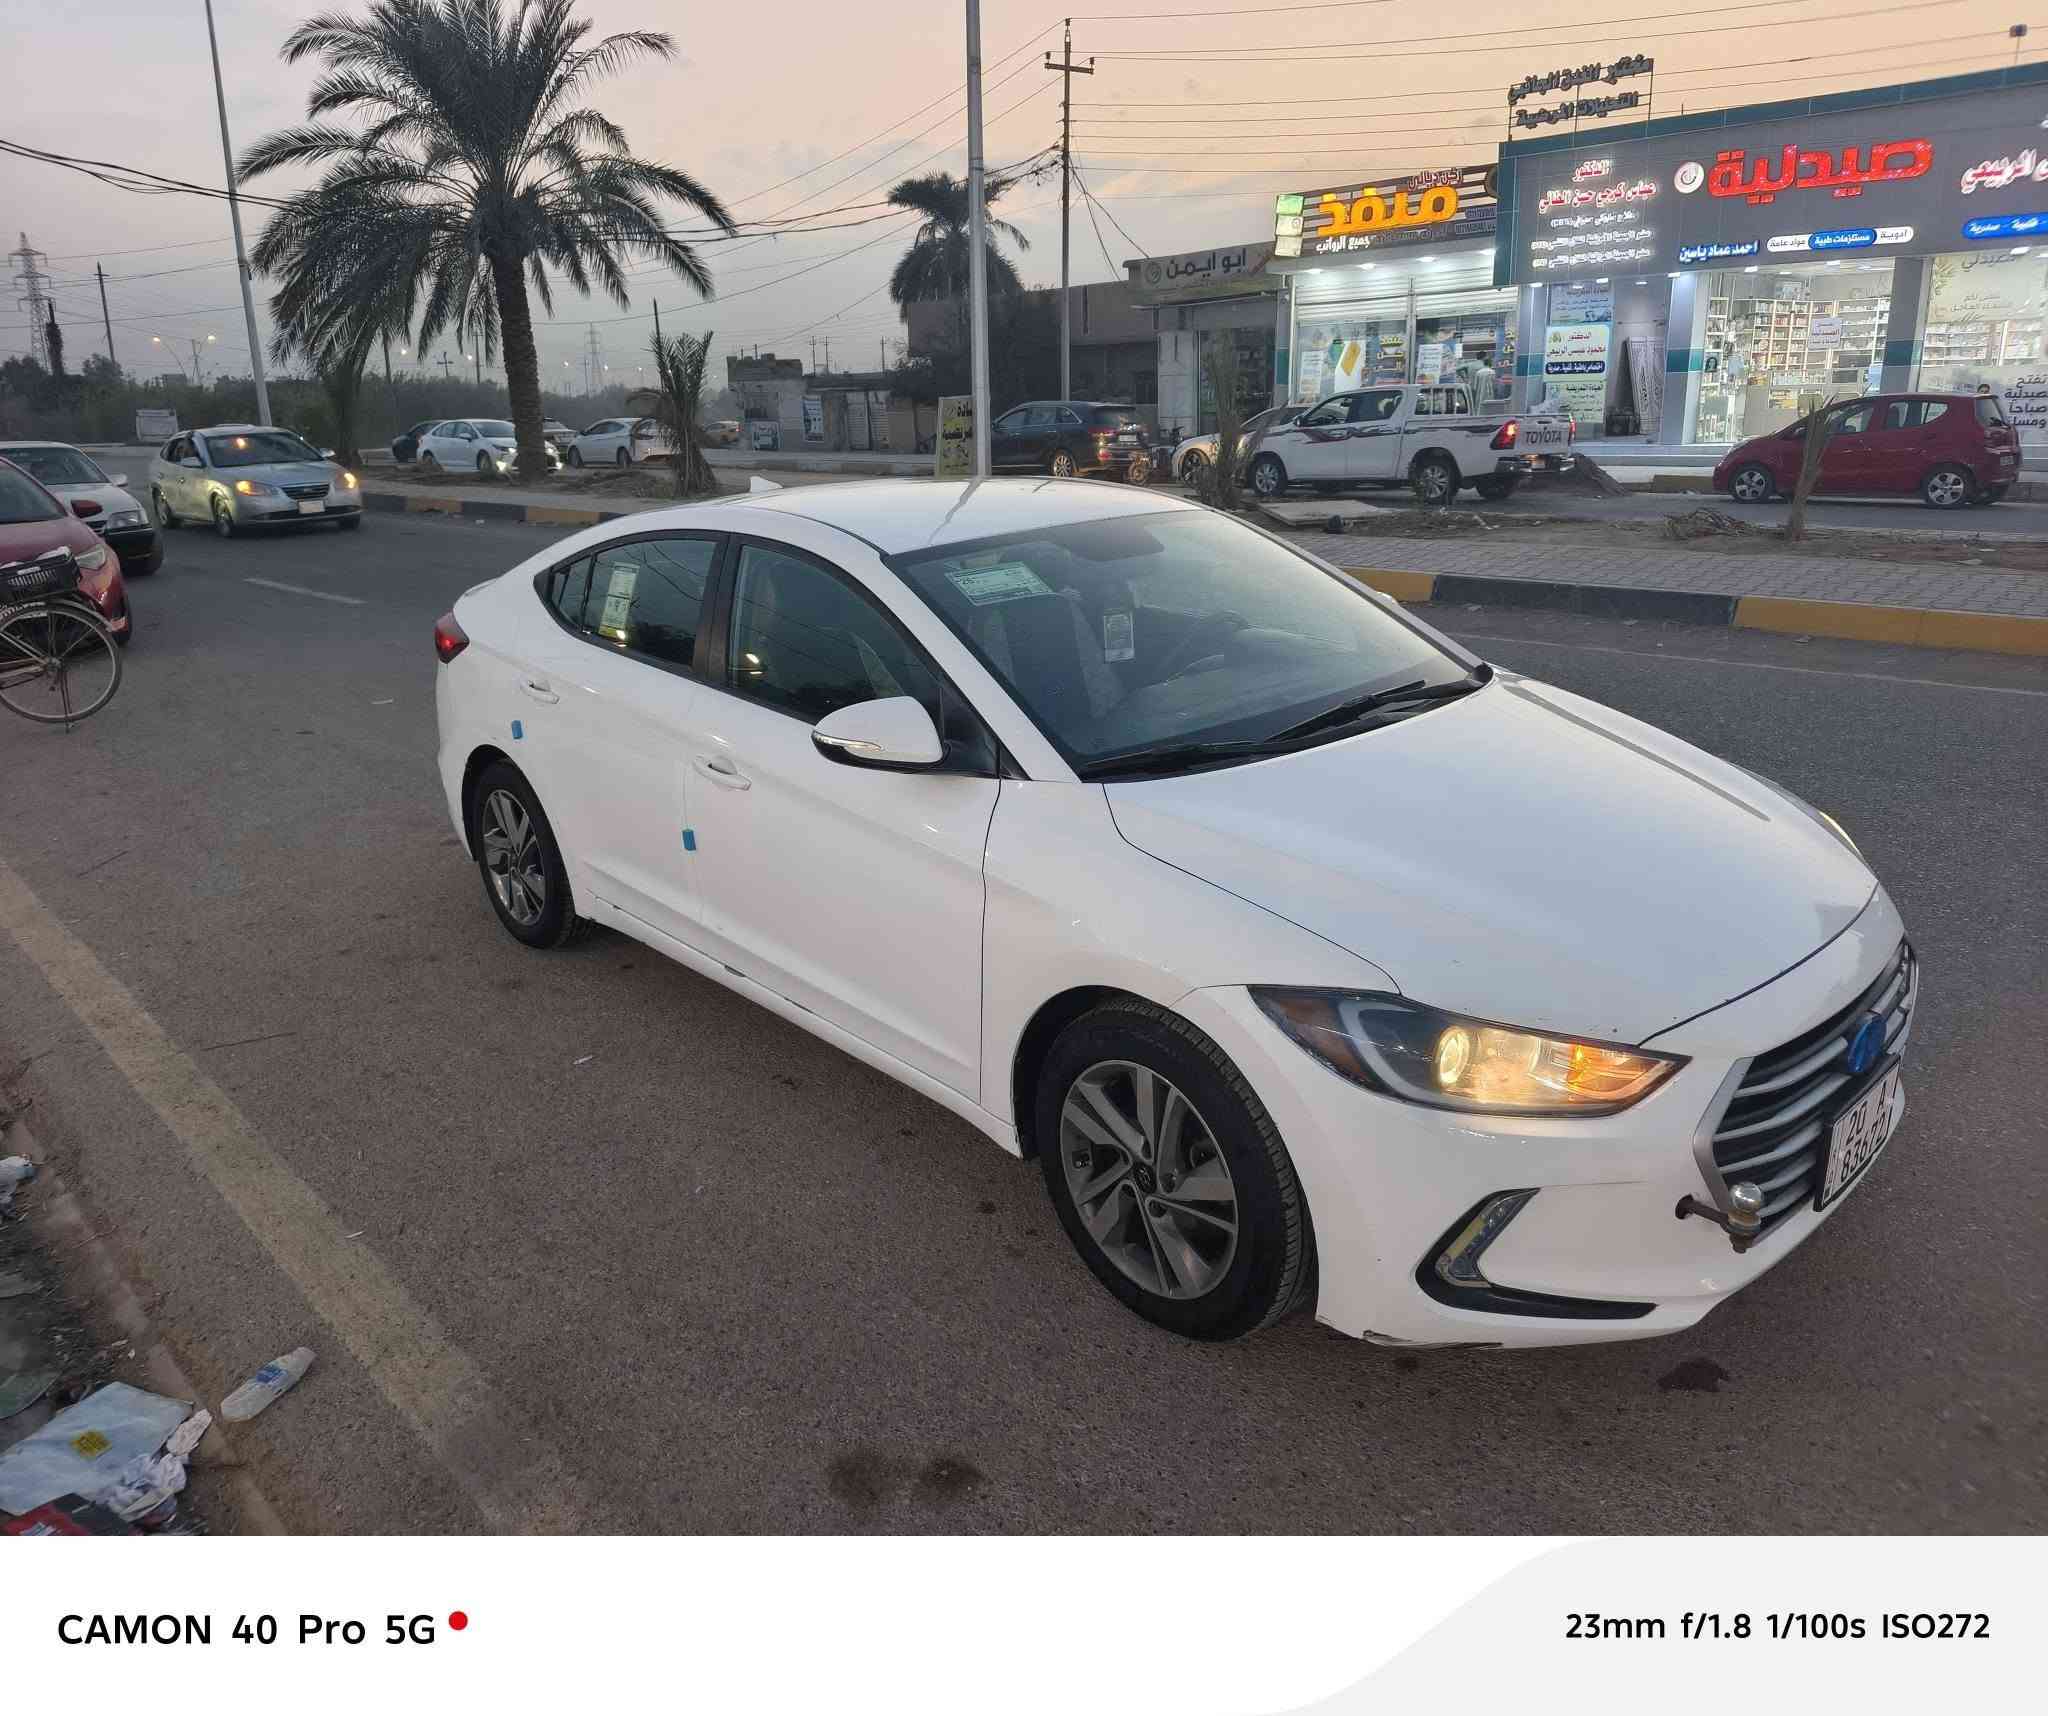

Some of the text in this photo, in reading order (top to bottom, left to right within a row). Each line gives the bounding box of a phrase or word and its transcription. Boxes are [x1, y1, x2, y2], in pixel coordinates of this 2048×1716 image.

[1572, 159, 1610, 182] الدكتور
[1707, 138, 1935, 206] صيدلية
[1316, 185, 1459, 237] منفذ
[1350, 236, 1371, 250] جميع
[1166, 248, 1246, 279] ابو ايمن
[1526, 430, 1562, 443] TOYOTA
[1846, 1080, 1887, 1146] 20 A
